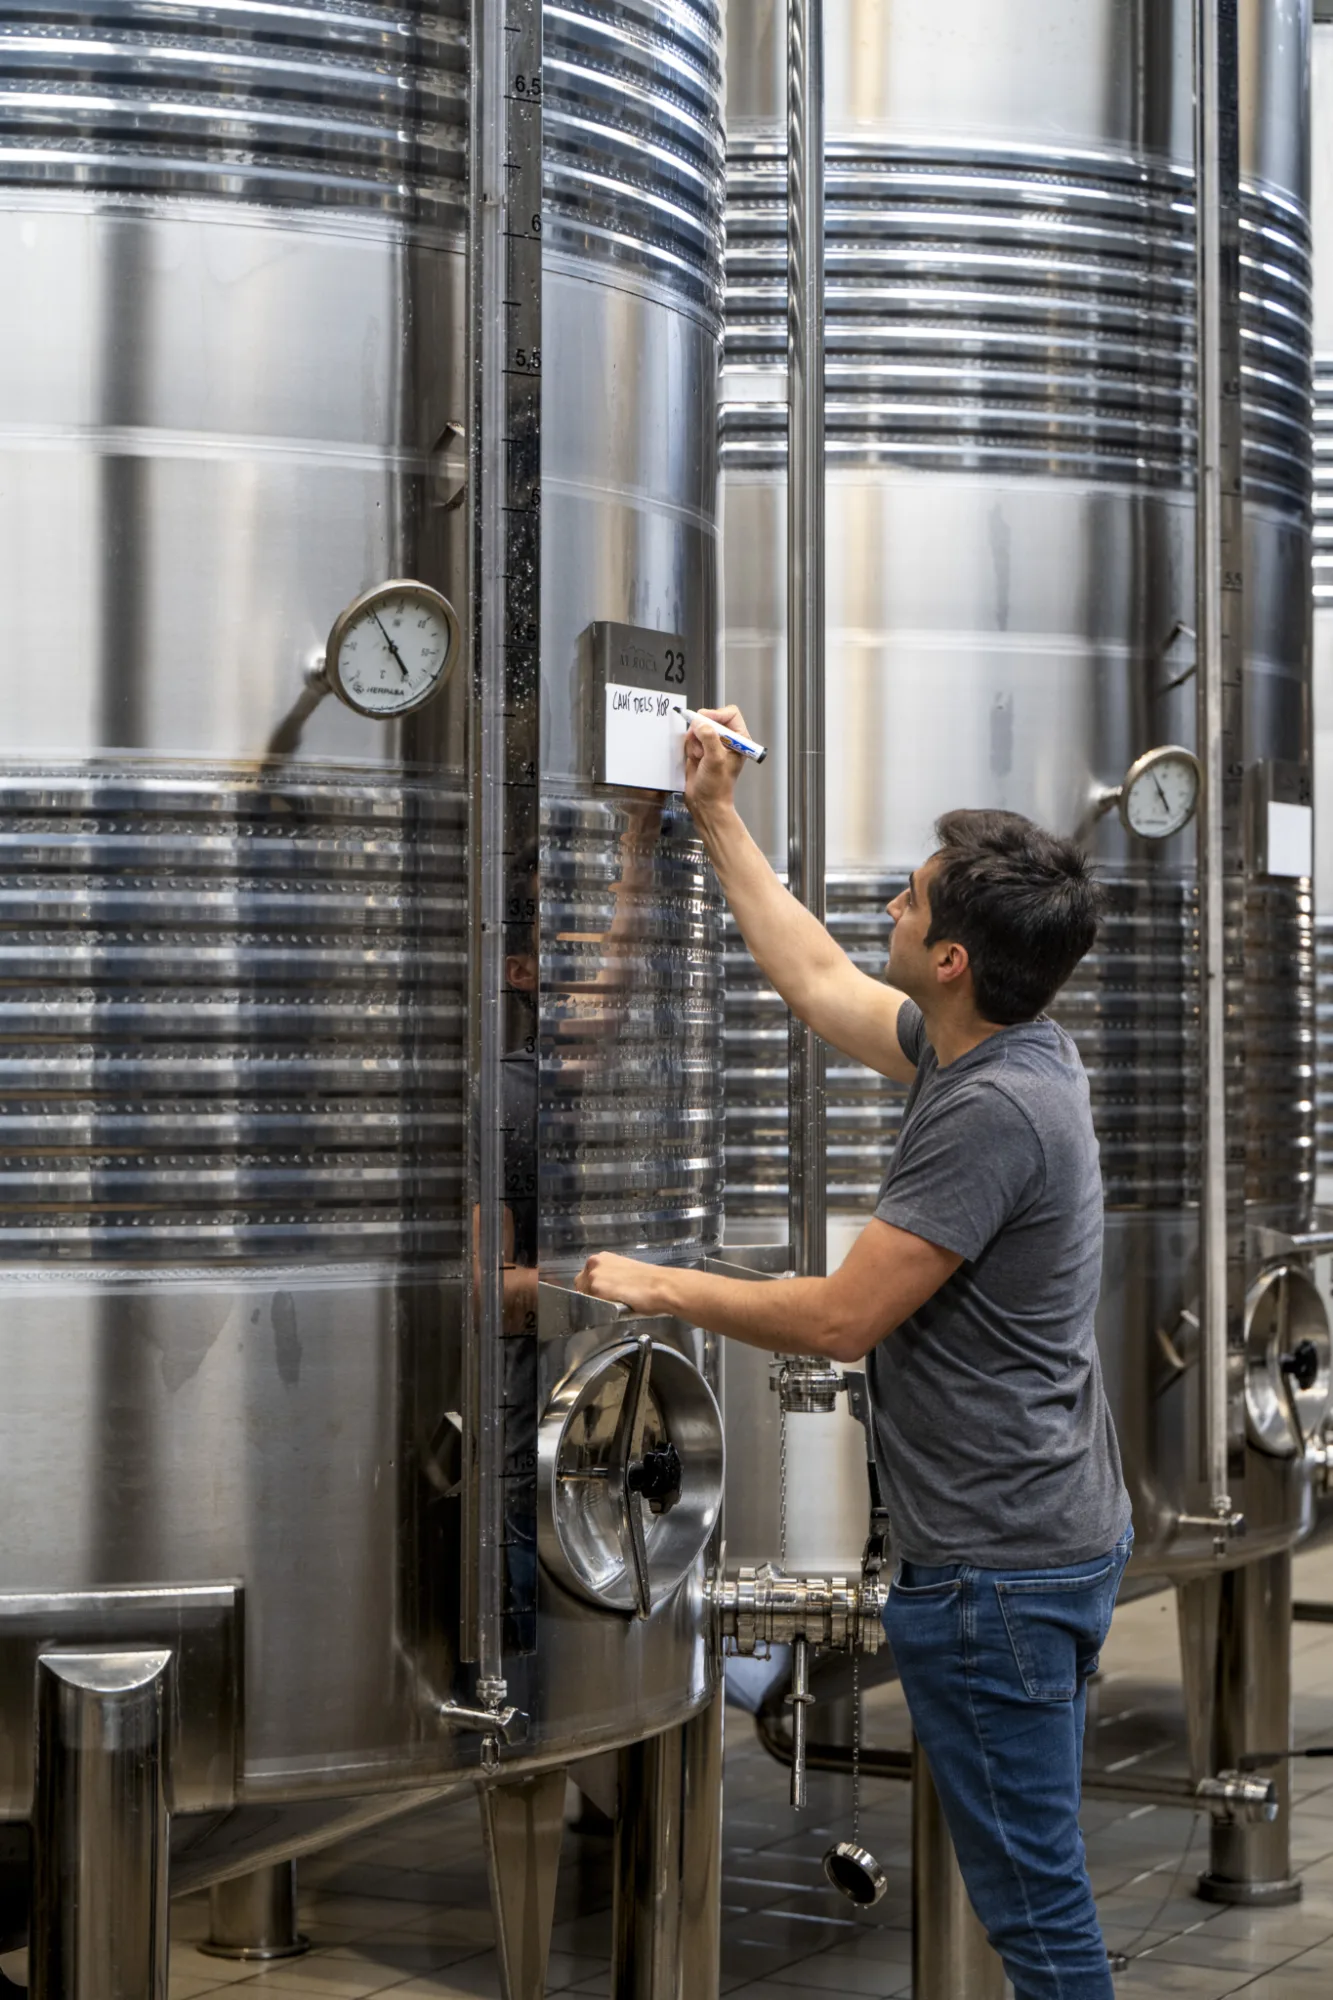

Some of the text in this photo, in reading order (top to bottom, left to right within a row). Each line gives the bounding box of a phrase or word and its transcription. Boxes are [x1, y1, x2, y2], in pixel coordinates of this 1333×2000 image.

[515, 74, 541, 97] 6,5
[531, 213, 541, 232] 6
[515, 349, 541, 369] 5,5
[531, 487, 541, 505] 5
[664, 648, 685, 684] 23
[633, 696, 654, 715] DELS
[525, 1310, 536, 1329] 2
